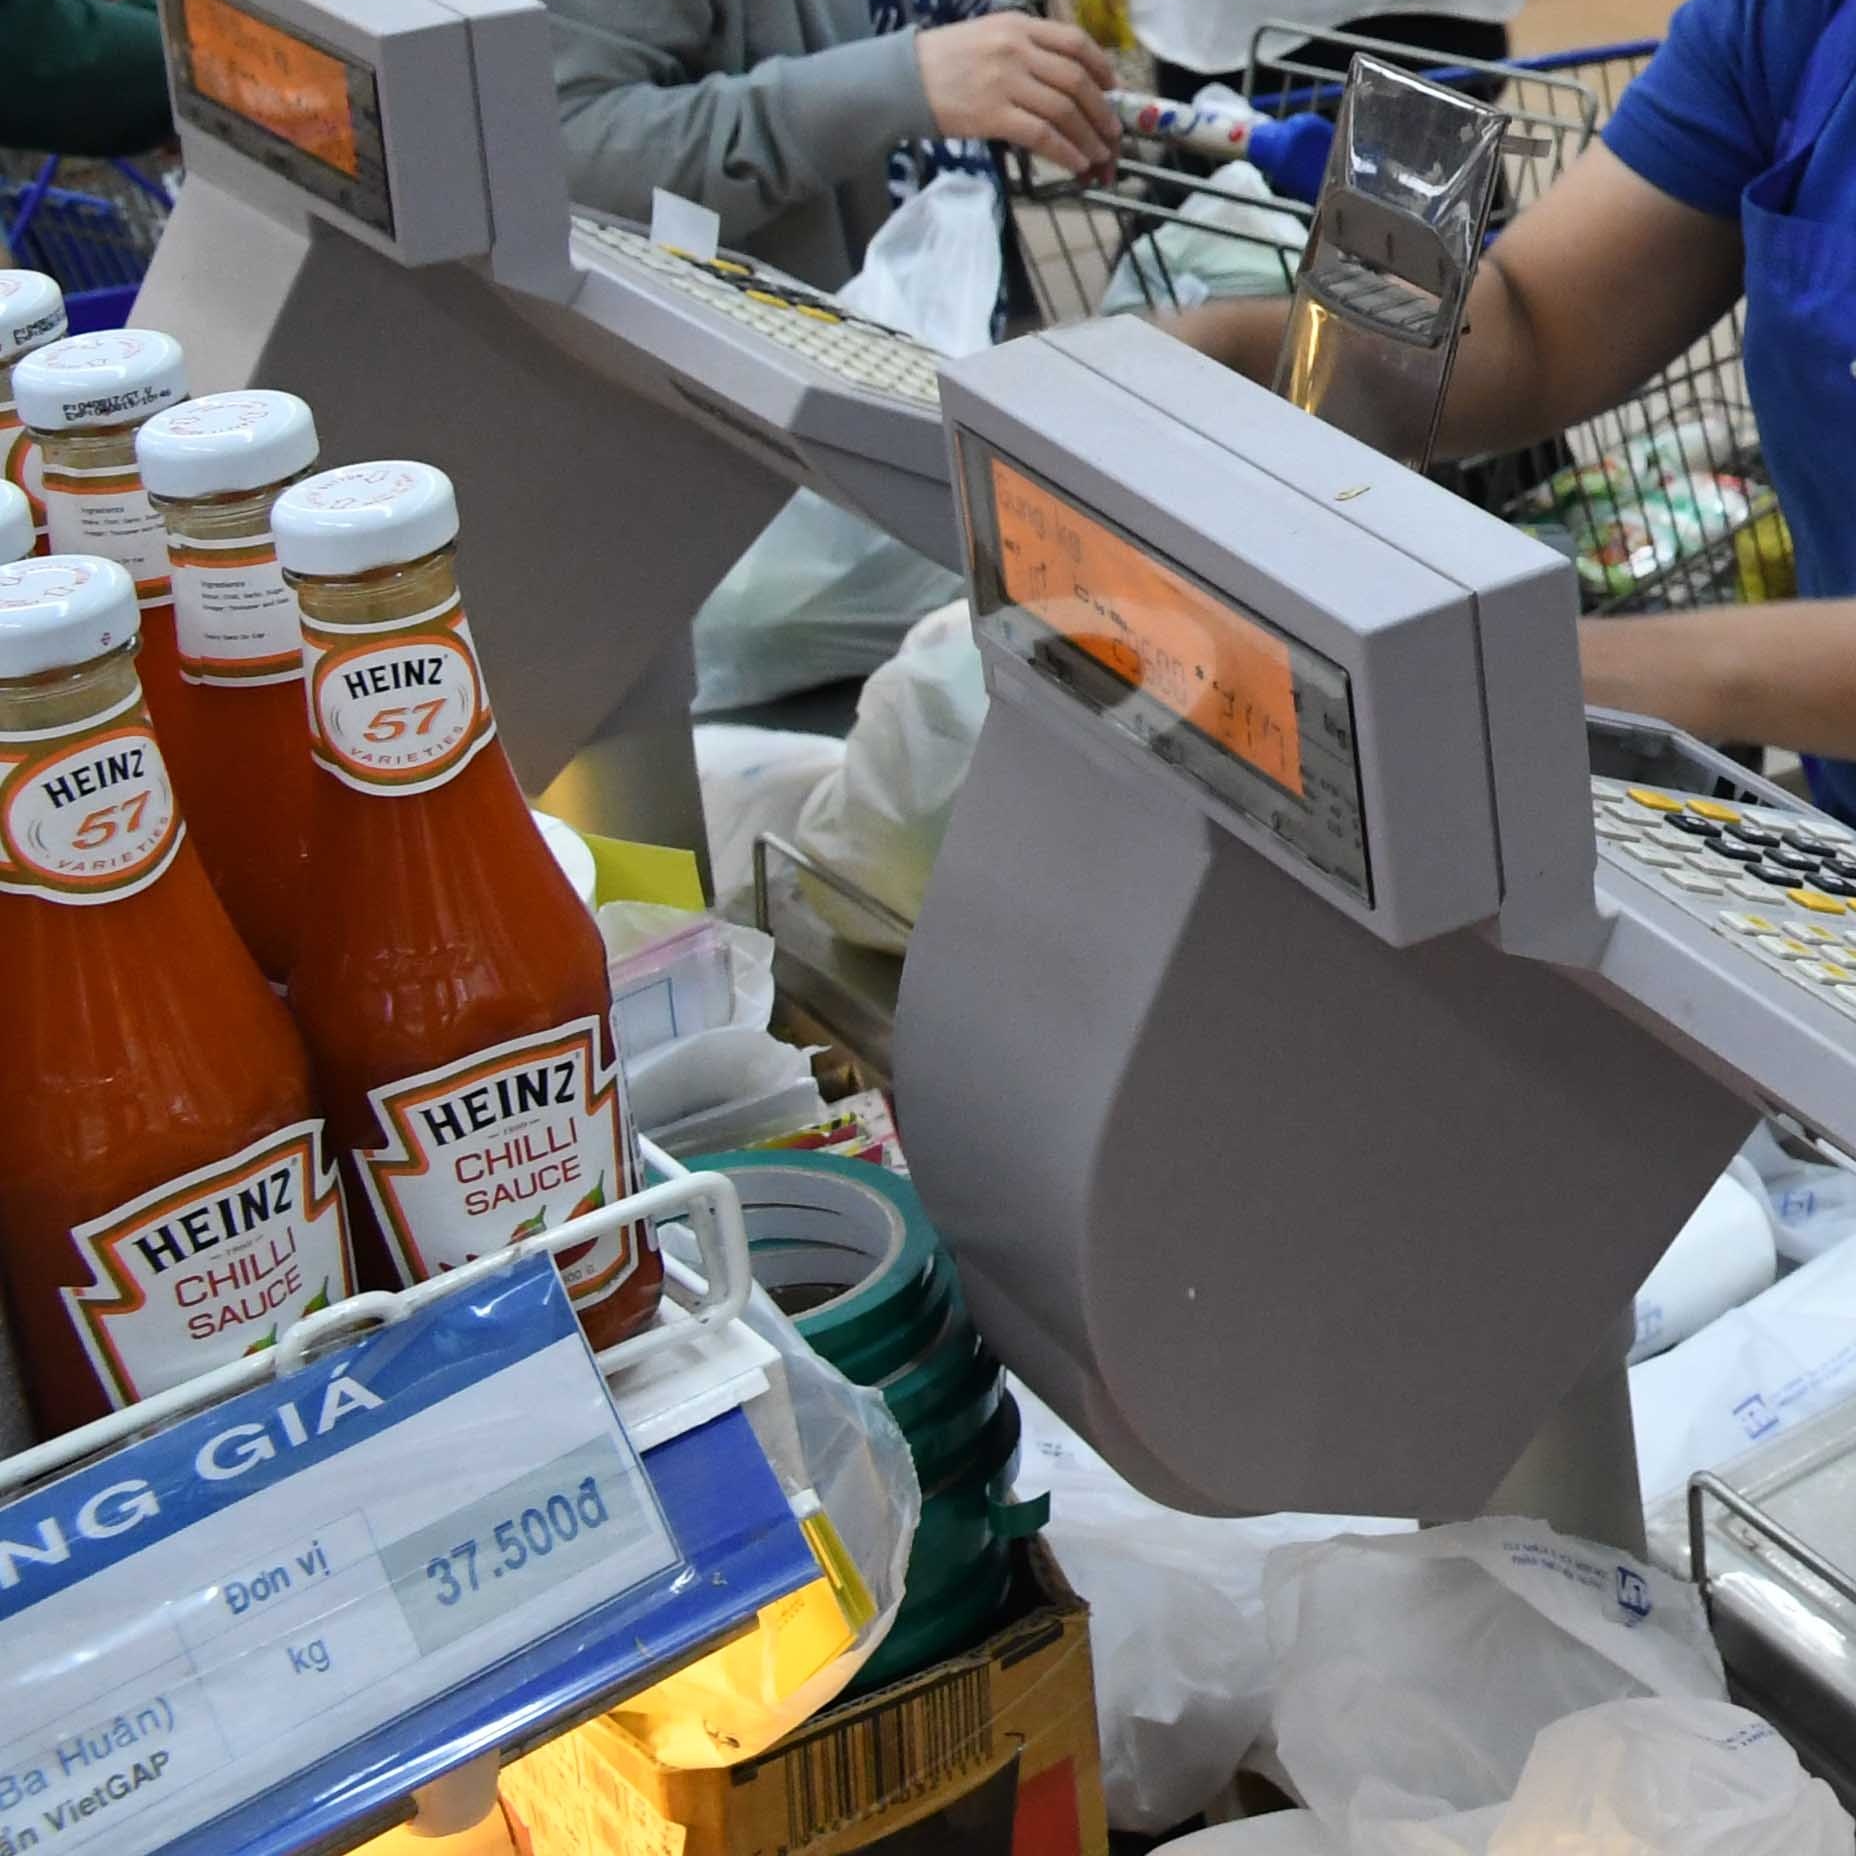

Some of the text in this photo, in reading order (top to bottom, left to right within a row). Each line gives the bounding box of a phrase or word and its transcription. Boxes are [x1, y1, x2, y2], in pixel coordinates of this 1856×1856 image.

[343, 657, 444, 700] HEINZ
[351, 725, 464, 765] VARIETIES
[362, 697, 448, 743] 57
[42, 748, 144, 809] HEINZ
[58, 815, 169, 872] VARIETIES
[71, 789, 152, 850] 57
[419, 1060, 576, 1146] HEINZ
[454, 1117, 579, 1184] CHILLI
[464, 1154, 582, 1217] SAUCE
[132, 1167, 293, 1275] HEINZ
[174, 1225, 297, 1308] CHILLI
[187, 1264, 303, 1341] SAUCE
[195, 1362, 385, 1481] GIÁ
[426, 1475, 610, 1607] 37.500đ
[223, 1539, 331, 1616] Đơn vị
[285, 1639, 332, 1675] kg
[43, 1750, 170, 1832] VietGAP
